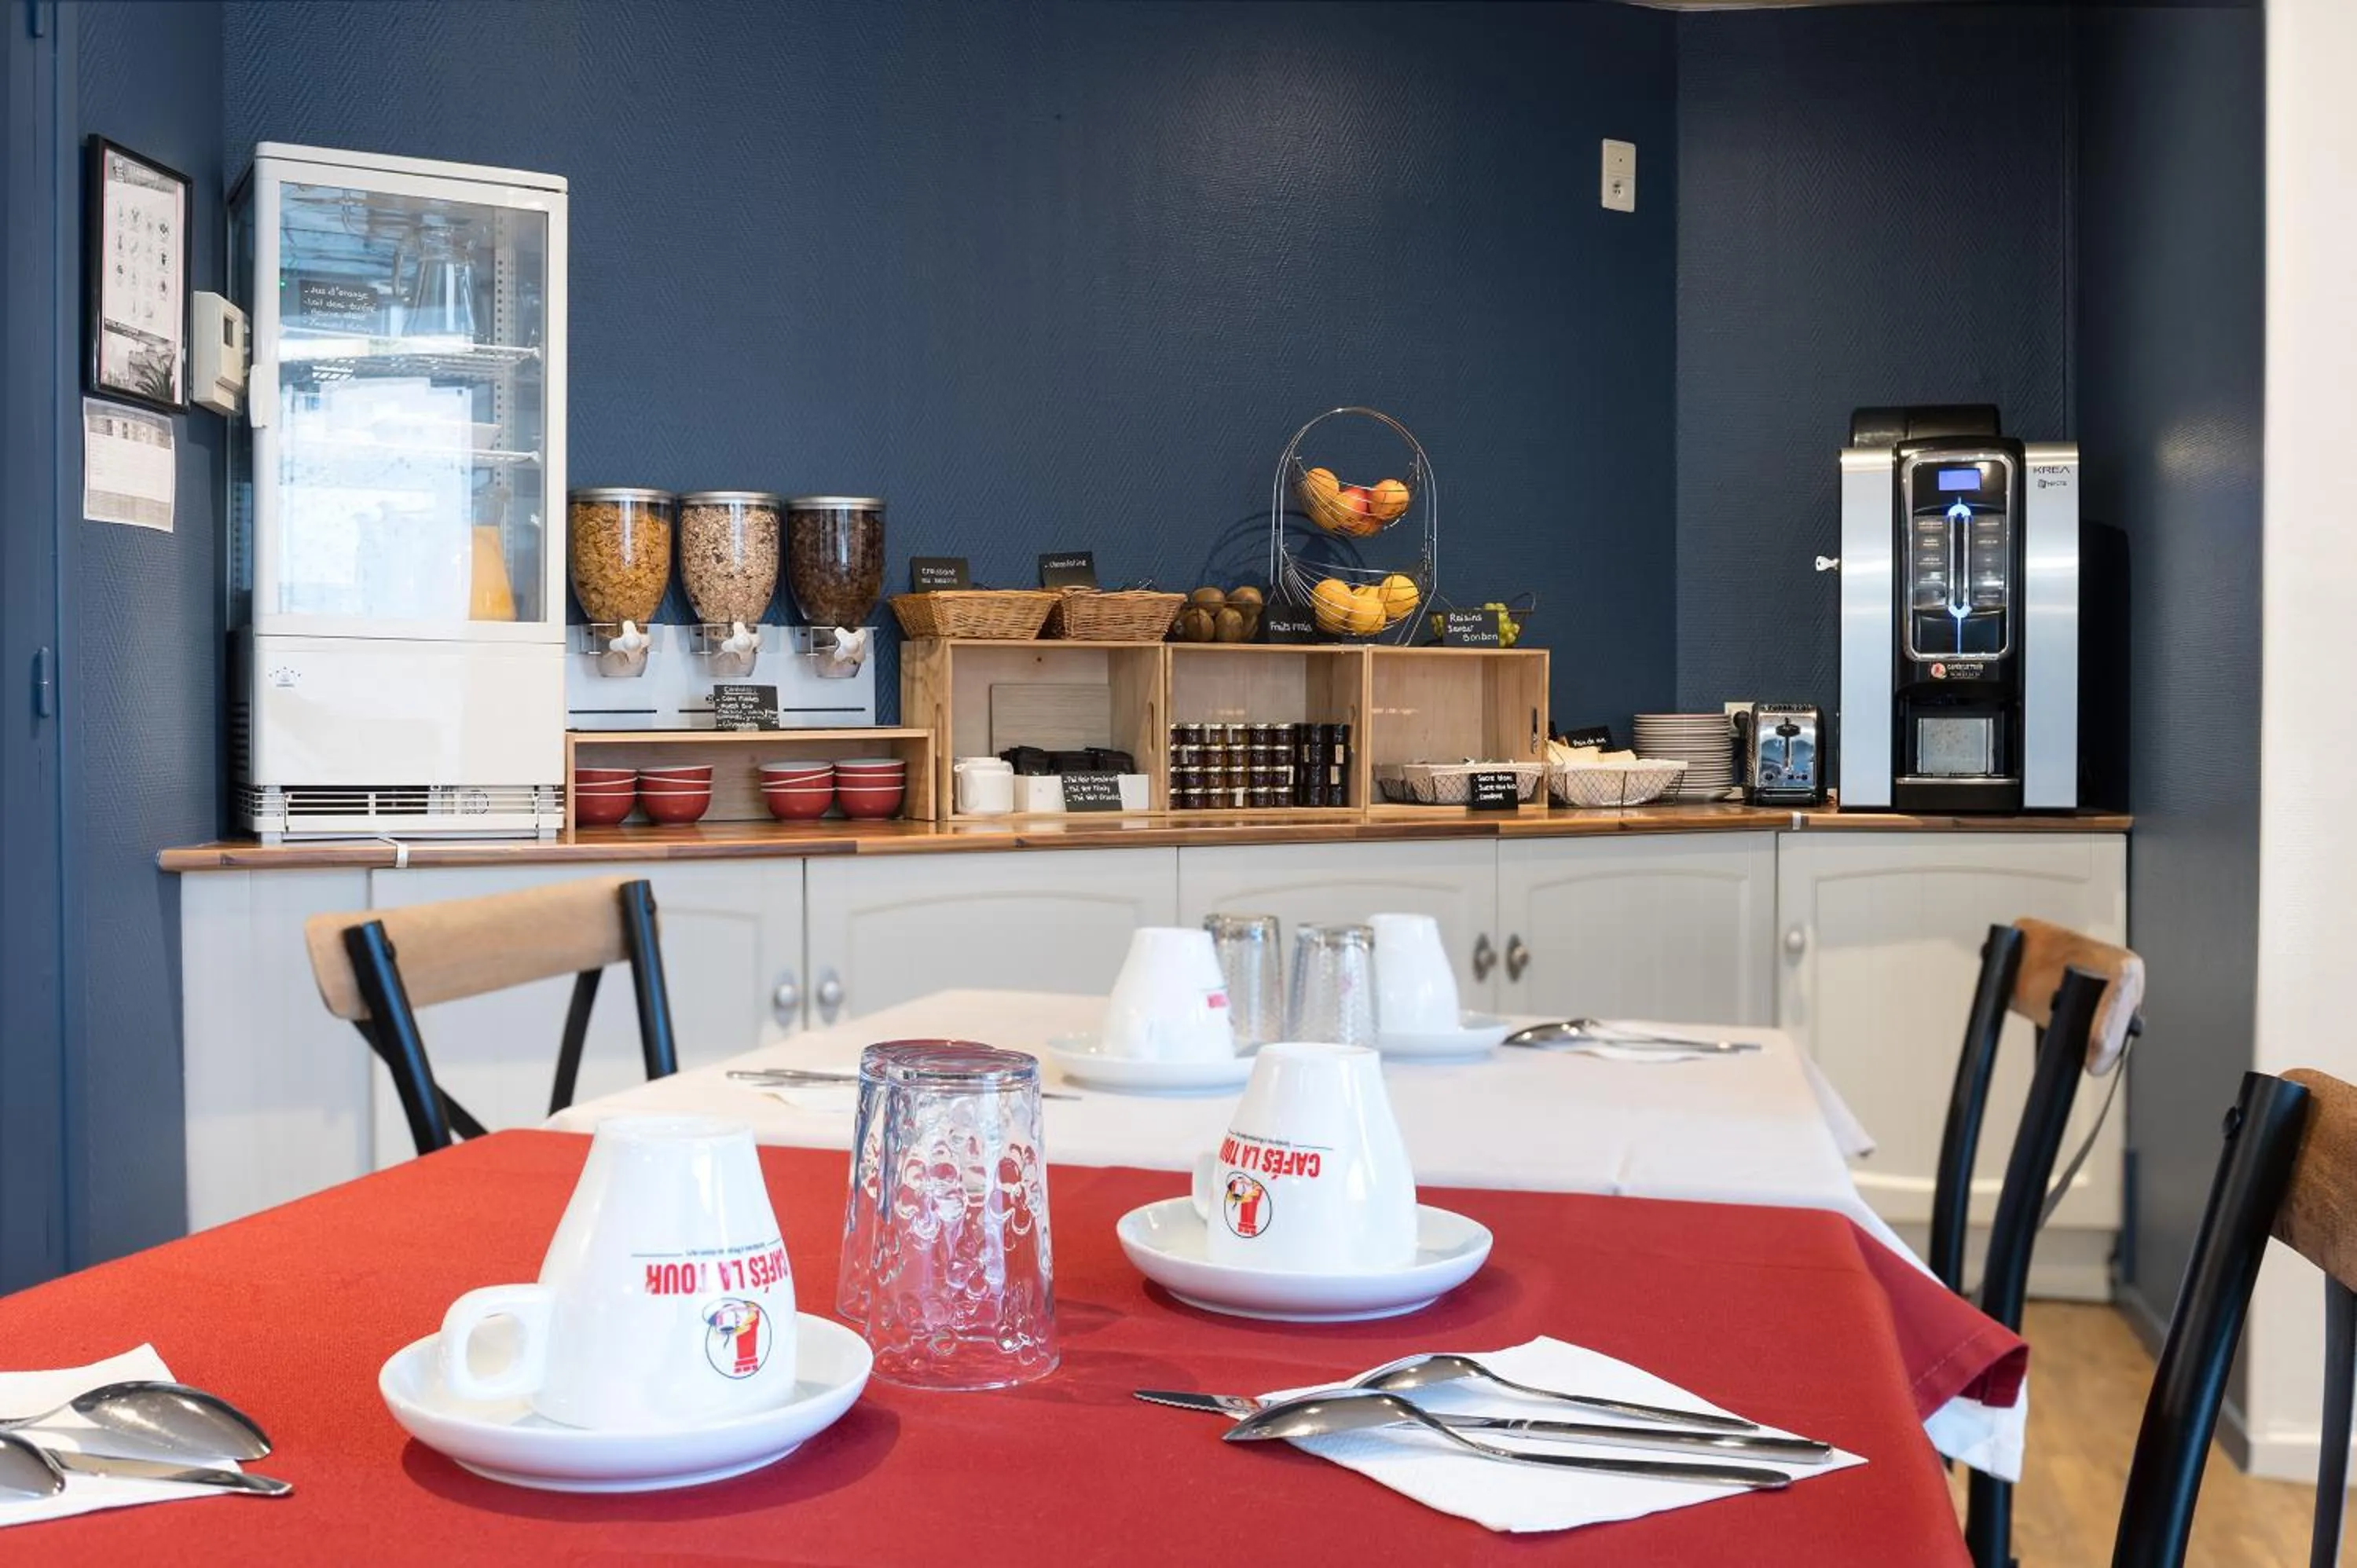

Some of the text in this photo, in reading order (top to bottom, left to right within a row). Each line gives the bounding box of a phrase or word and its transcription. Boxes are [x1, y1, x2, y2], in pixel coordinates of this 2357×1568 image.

[1241, 1144, 1261, 1170] LA
[1261, 1147, 1321, 1180] CAFÉS
[717, 1258, 746, 1291] LA
